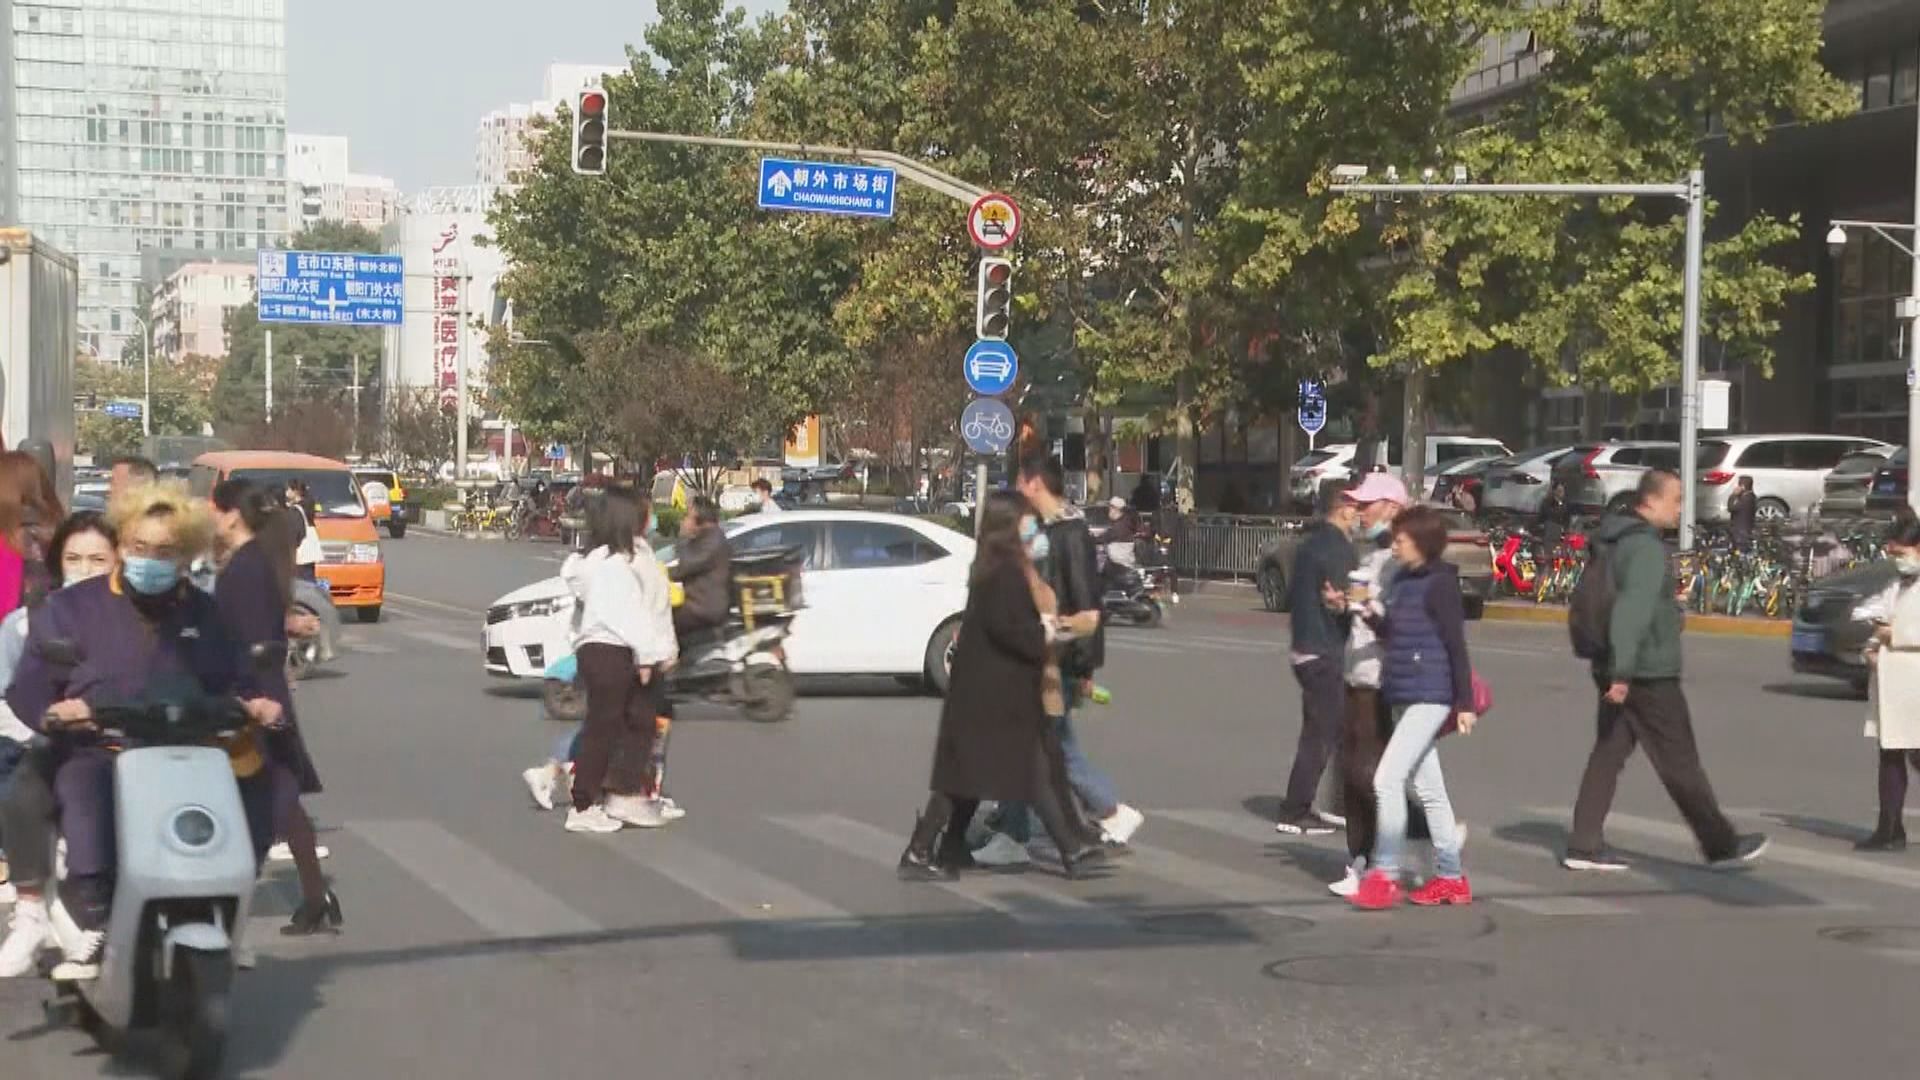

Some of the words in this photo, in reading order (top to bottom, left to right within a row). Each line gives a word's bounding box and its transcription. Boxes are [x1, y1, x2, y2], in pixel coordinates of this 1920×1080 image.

[793, 168, 888, 194] 朝外市场街
[793, 192, 872, 208] CHAOWAISHICHANG
[875, 198, 885, 209] St
[297, 254, 355, 272] 吉市口东路
[261, 278, 320, 295] 朝阳门外大街
[345, 280, 402, 297] 朝阳门外大街
[355, 307, 397, 320] (东大桥)
